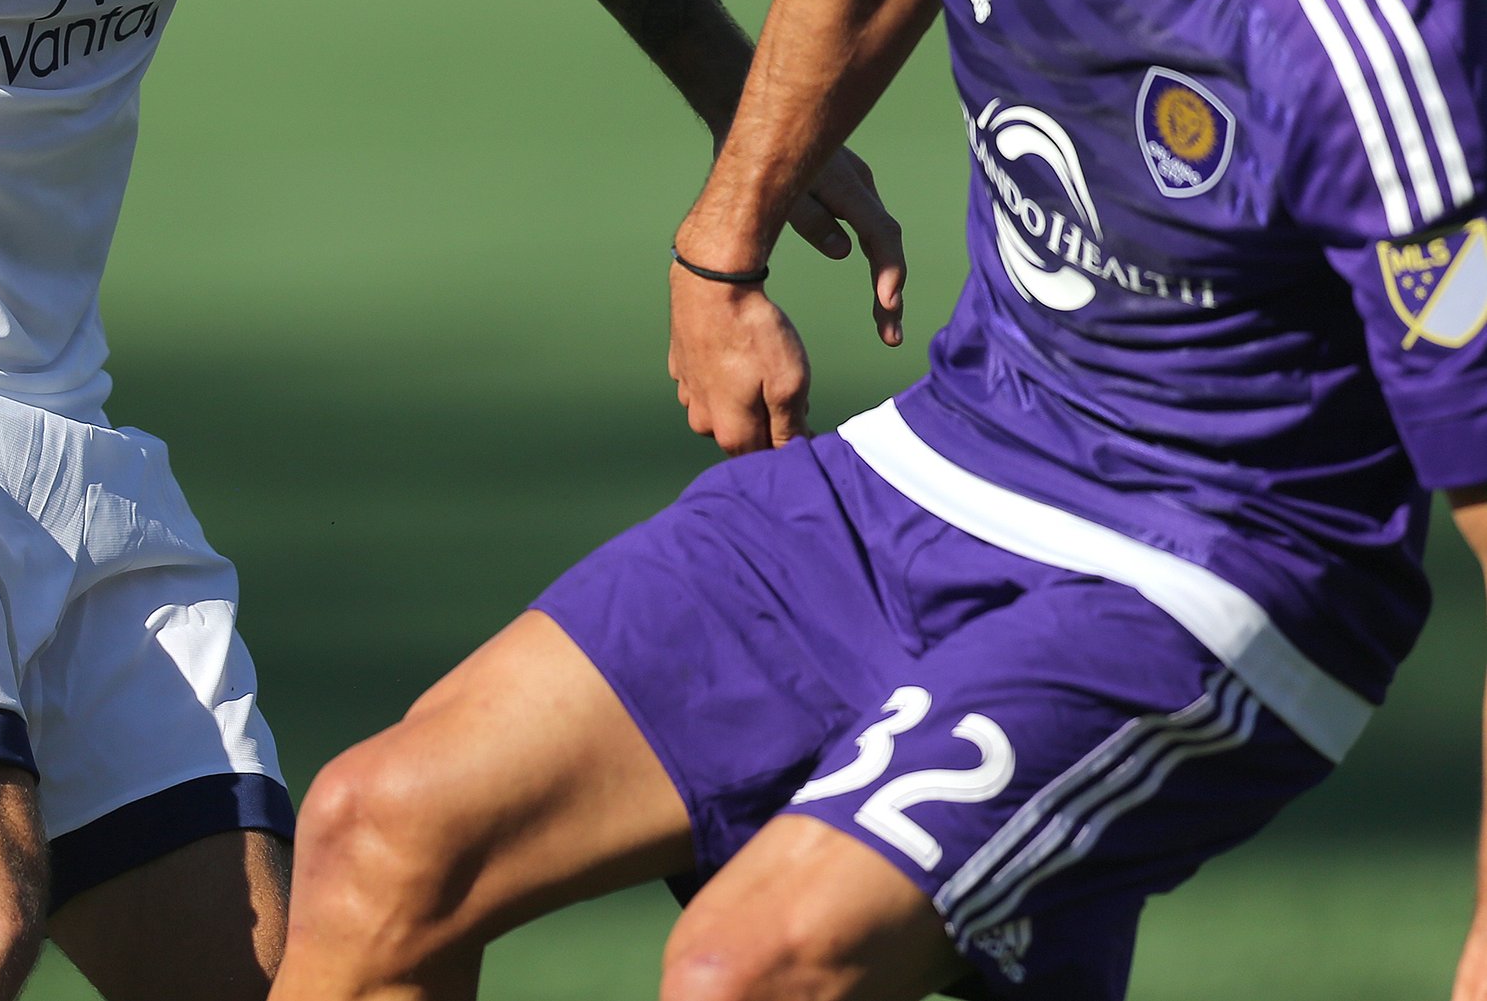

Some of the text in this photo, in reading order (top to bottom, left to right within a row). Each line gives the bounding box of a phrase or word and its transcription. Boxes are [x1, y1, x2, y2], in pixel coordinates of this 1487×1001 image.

[1046, 210, 1216, 310] HEALTH
[1389, 237, 1451, 276] MLS
[790, 685, 1016, 872] 32
